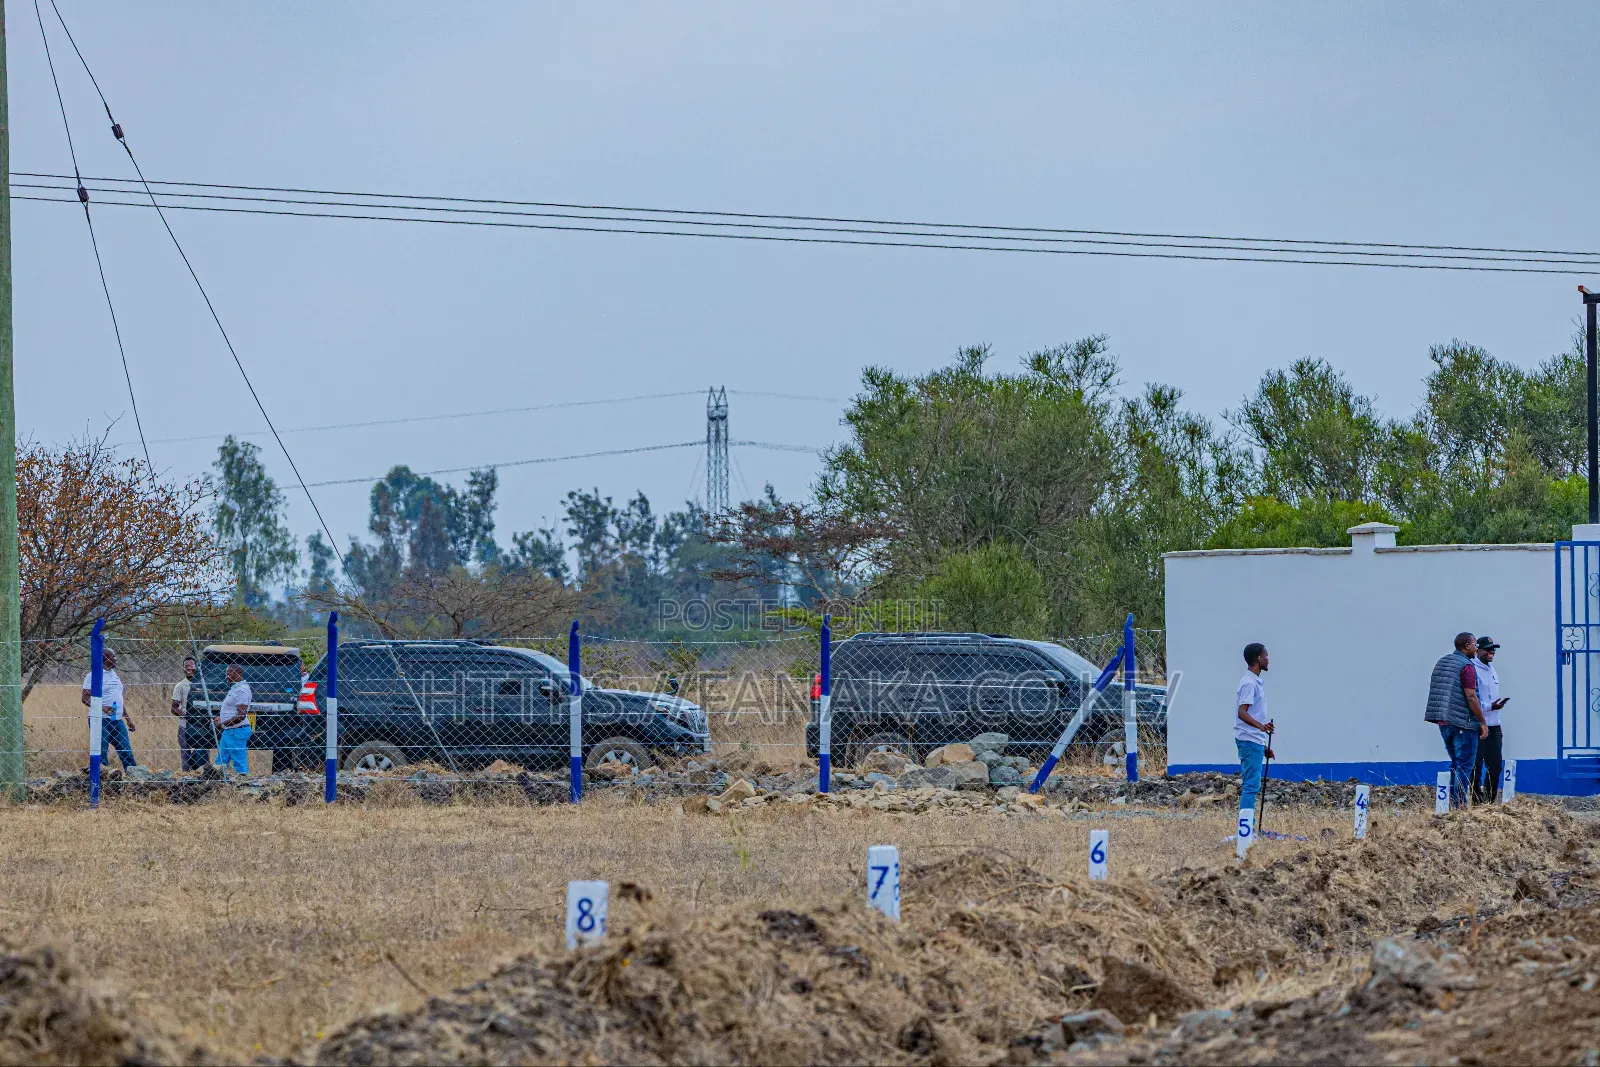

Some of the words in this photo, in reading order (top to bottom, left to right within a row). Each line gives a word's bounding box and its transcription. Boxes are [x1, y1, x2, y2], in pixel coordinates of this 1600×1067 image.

[1504, 769, 1512, 782] 2
[1356, 793, 1367, 810] 4
[1437, 785, 1448, 800] 3
[1238, 818, 1251, 838] 5
[1091, 839, 1105, 864] 6
[871, 865, 890, 899] 7
[577, 897, 595, 932] 8
